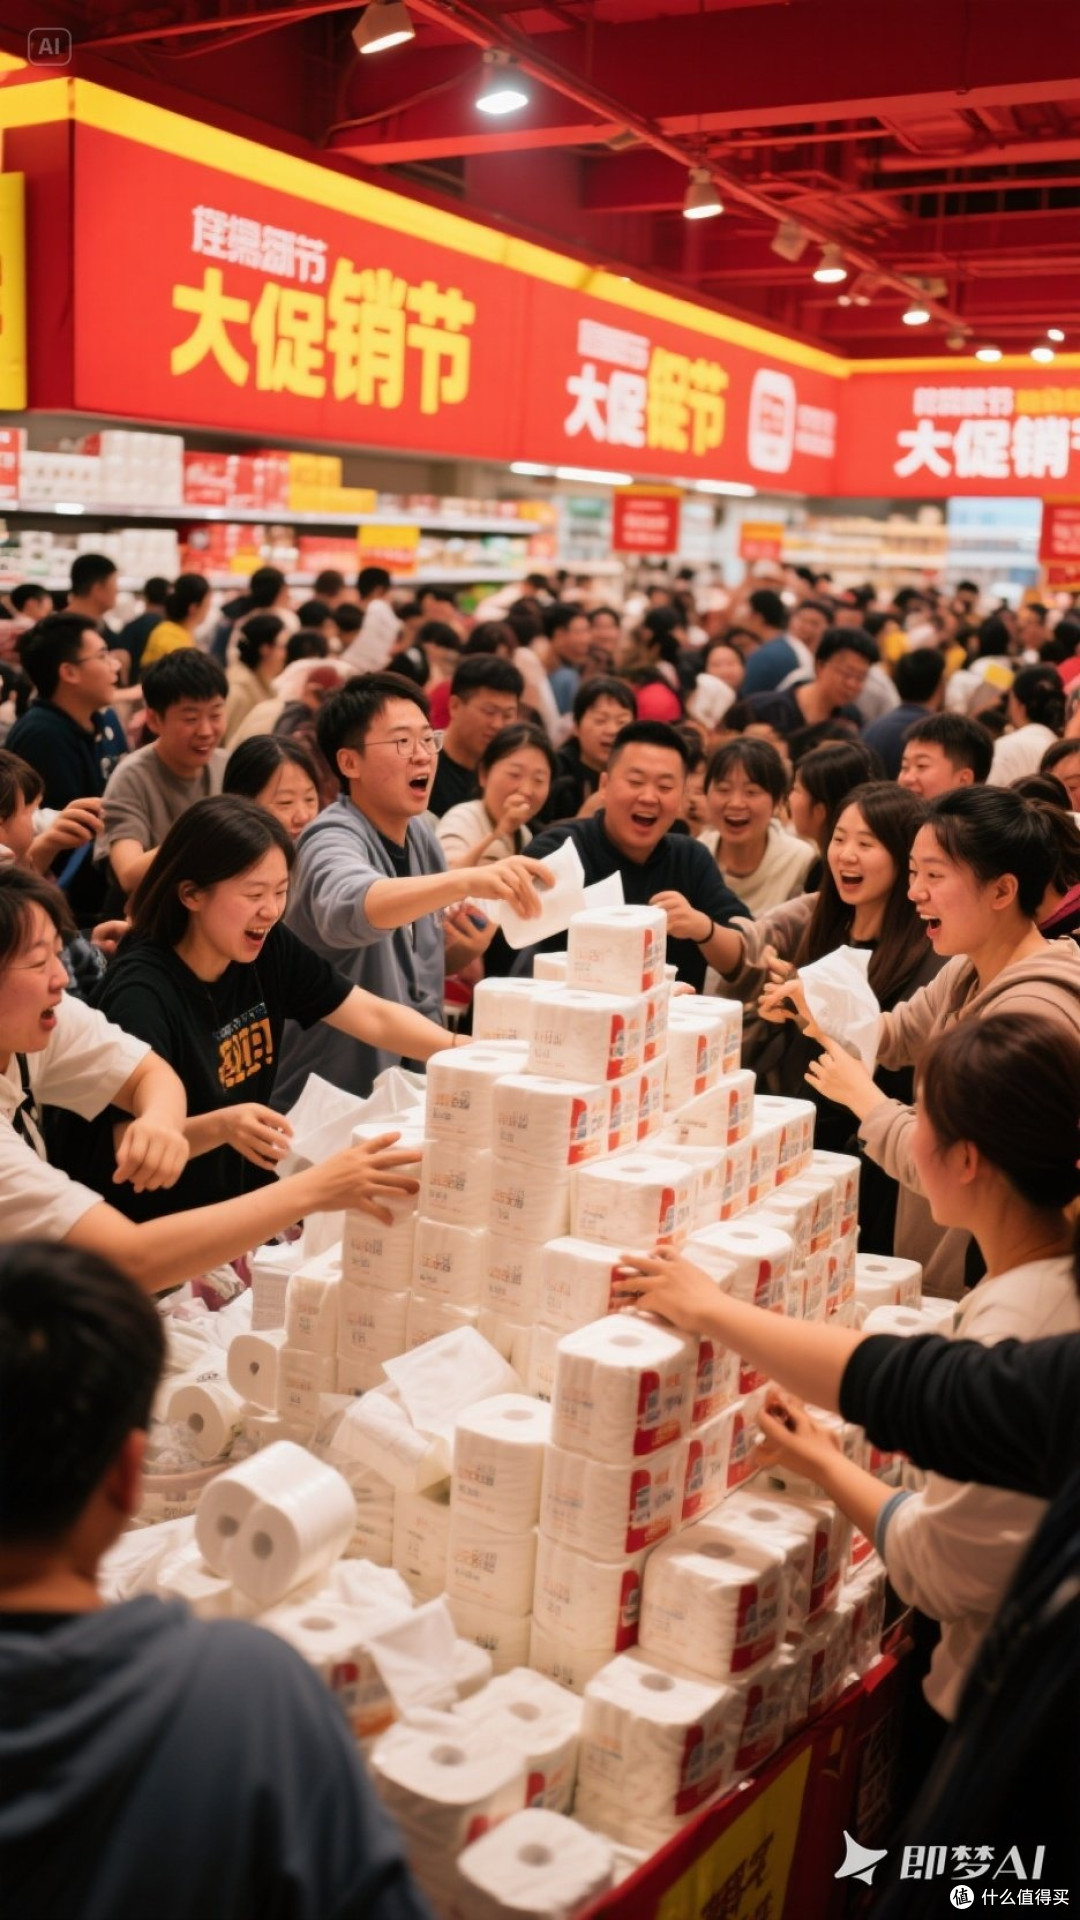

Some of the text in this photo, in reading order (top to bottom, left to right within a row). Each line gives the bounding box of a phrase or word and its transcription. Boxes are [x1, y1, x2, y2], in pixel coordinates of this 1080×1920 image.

[170, 257, 477, 415] 大促销节
[893, 415, 1080, 479] 大促销
